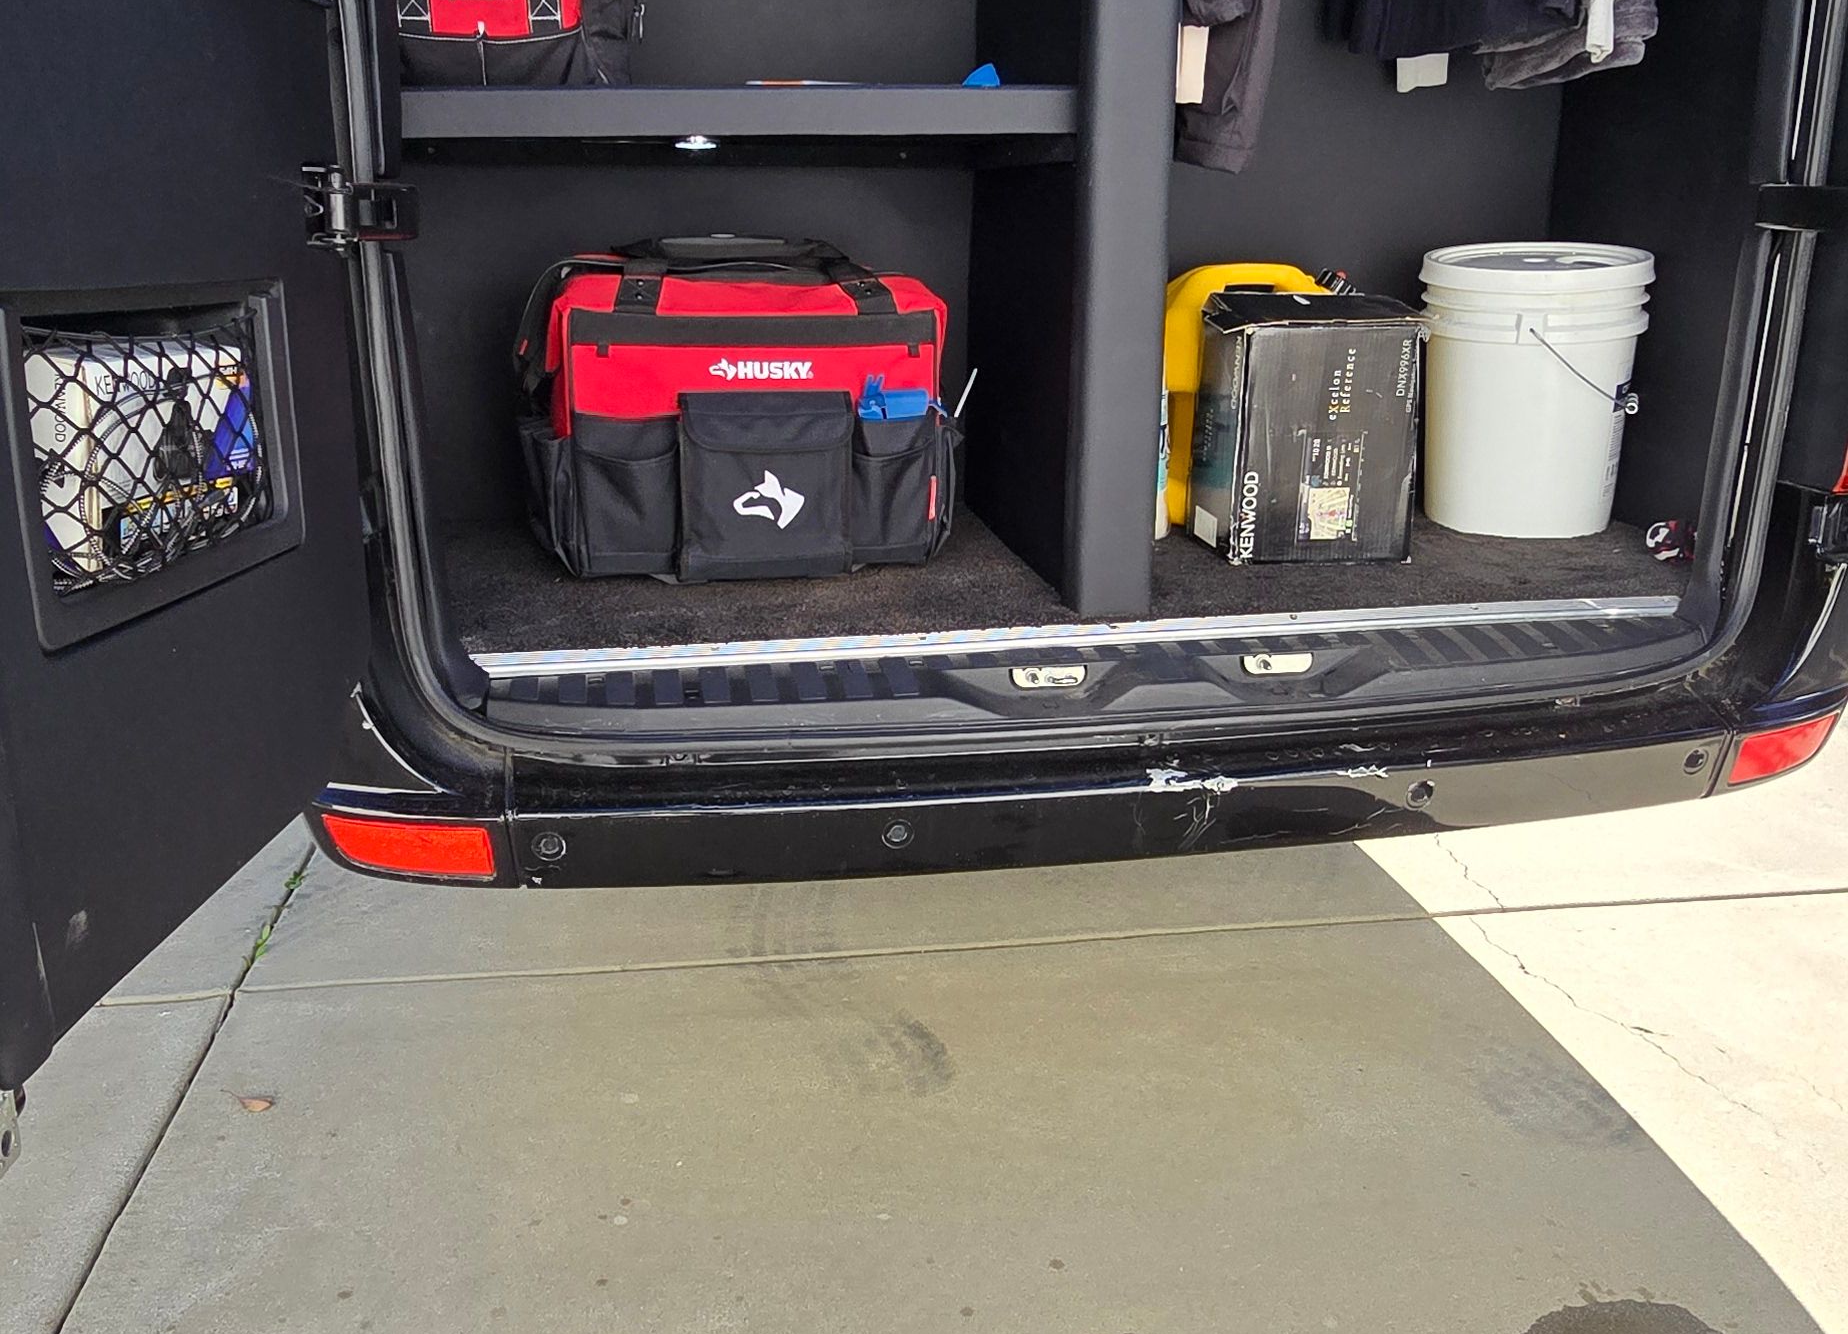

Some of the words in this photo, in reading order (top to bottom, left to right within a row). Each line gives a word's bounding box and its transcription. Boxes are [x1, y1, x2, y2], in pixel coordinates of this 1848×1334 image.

[737, 361, 812, 380] HUSKY
[1230, 335, 1242, 410] KENWOOD
[1328, 369, 1342, 421] eXcelon
[1340, 347, 1357, 414] Reference
[1396, 338, 1413, 397] DNX996XR
[1239, 471, 1259, 559] KENWOOD
